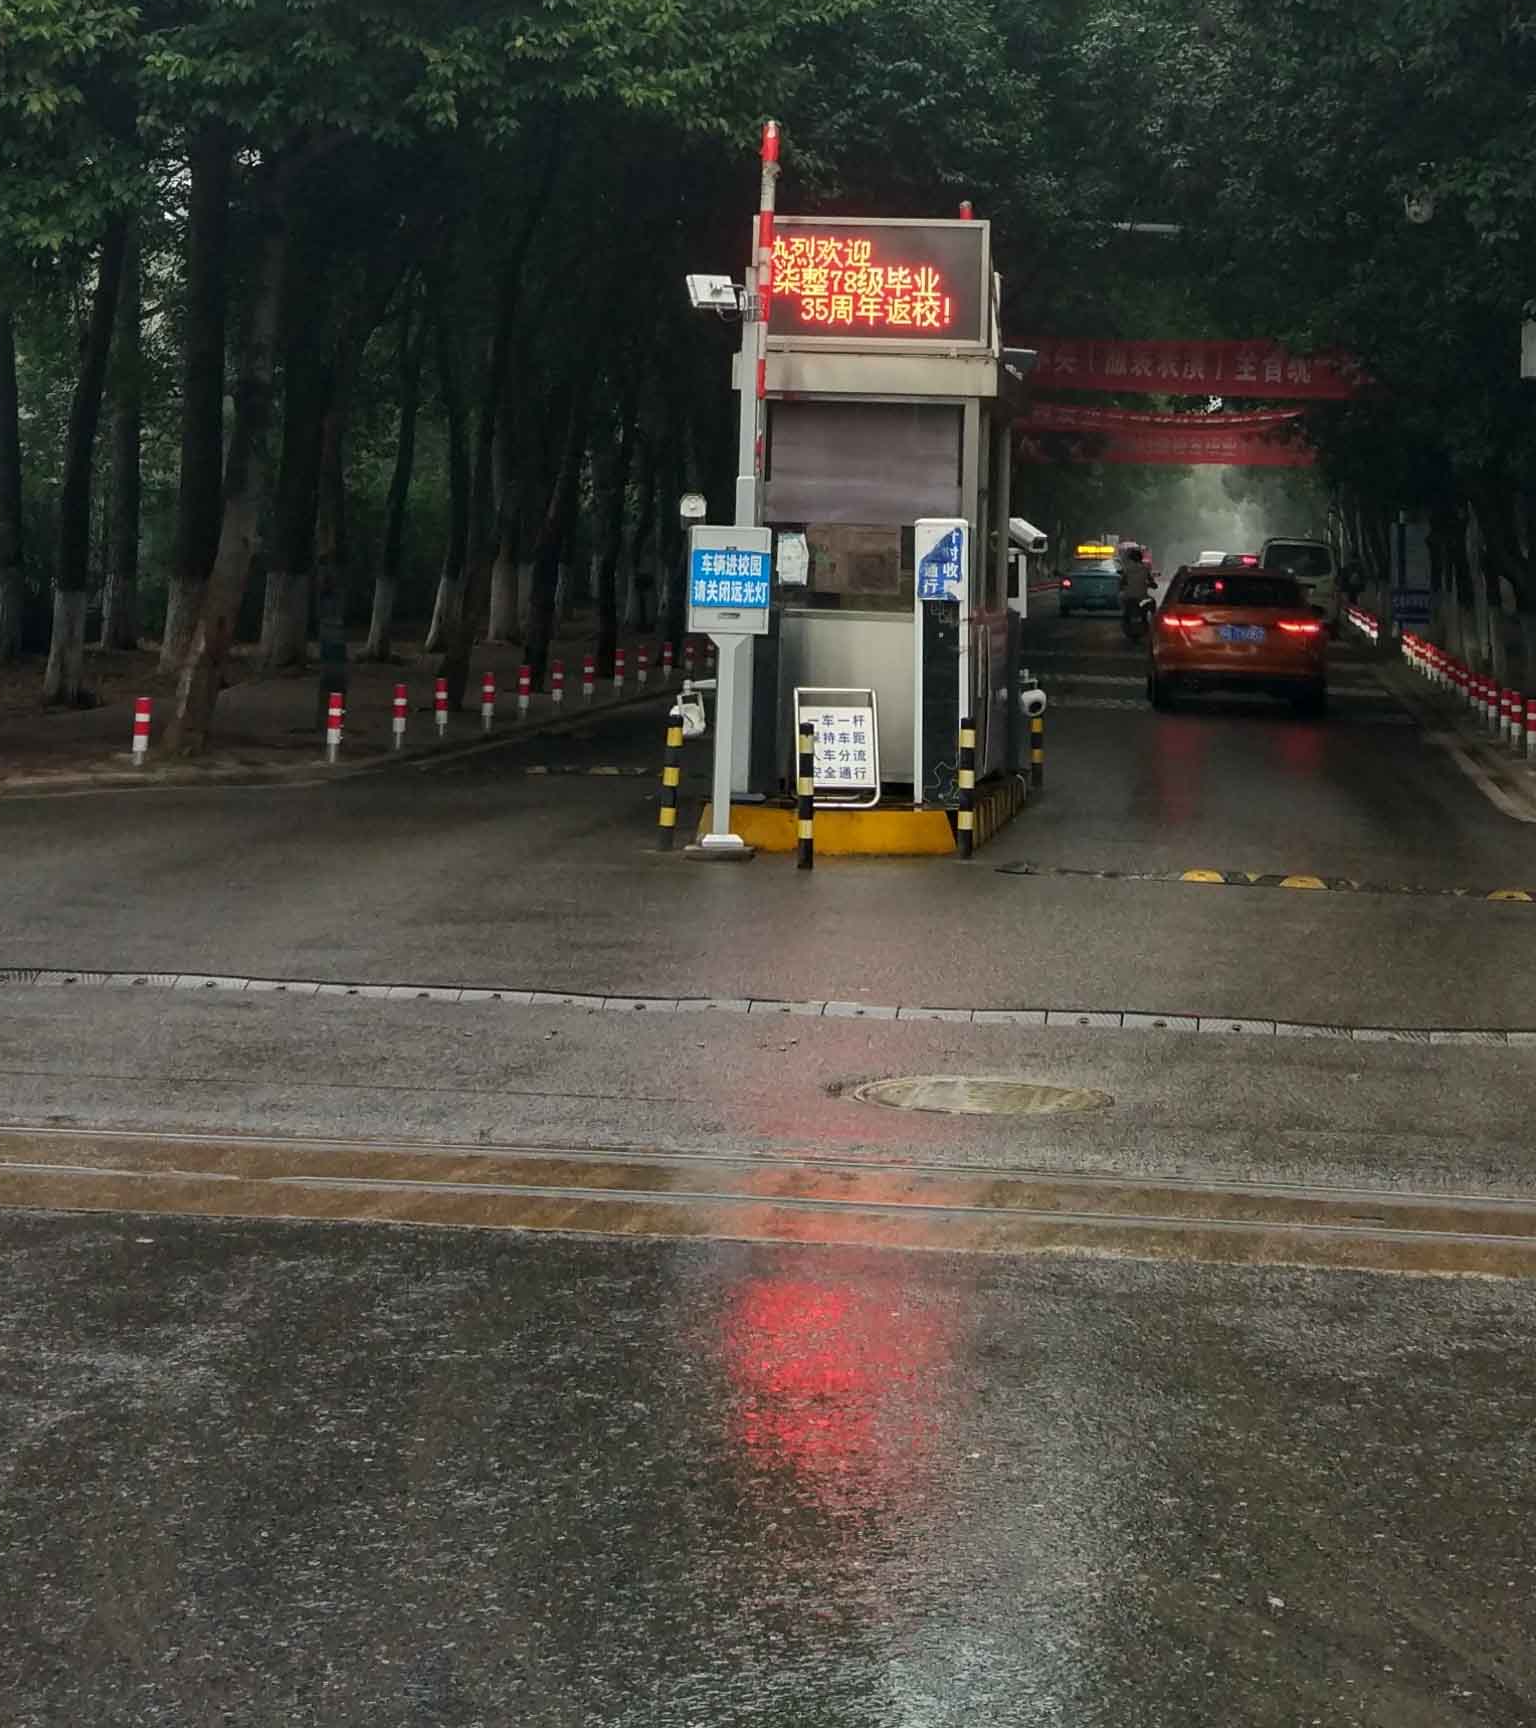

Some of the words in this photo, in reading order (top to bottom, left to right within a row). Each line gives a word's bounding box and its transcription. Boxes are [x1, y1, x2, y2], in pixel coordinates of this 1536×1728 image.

[771, 235, 873, 268] 热烈欢迎
[700, 553, 763, 577] 车辆进校园
[694, 579, 769, 603] 请关闭远光灯
[807, 714, 865, 728] 一车一杆
